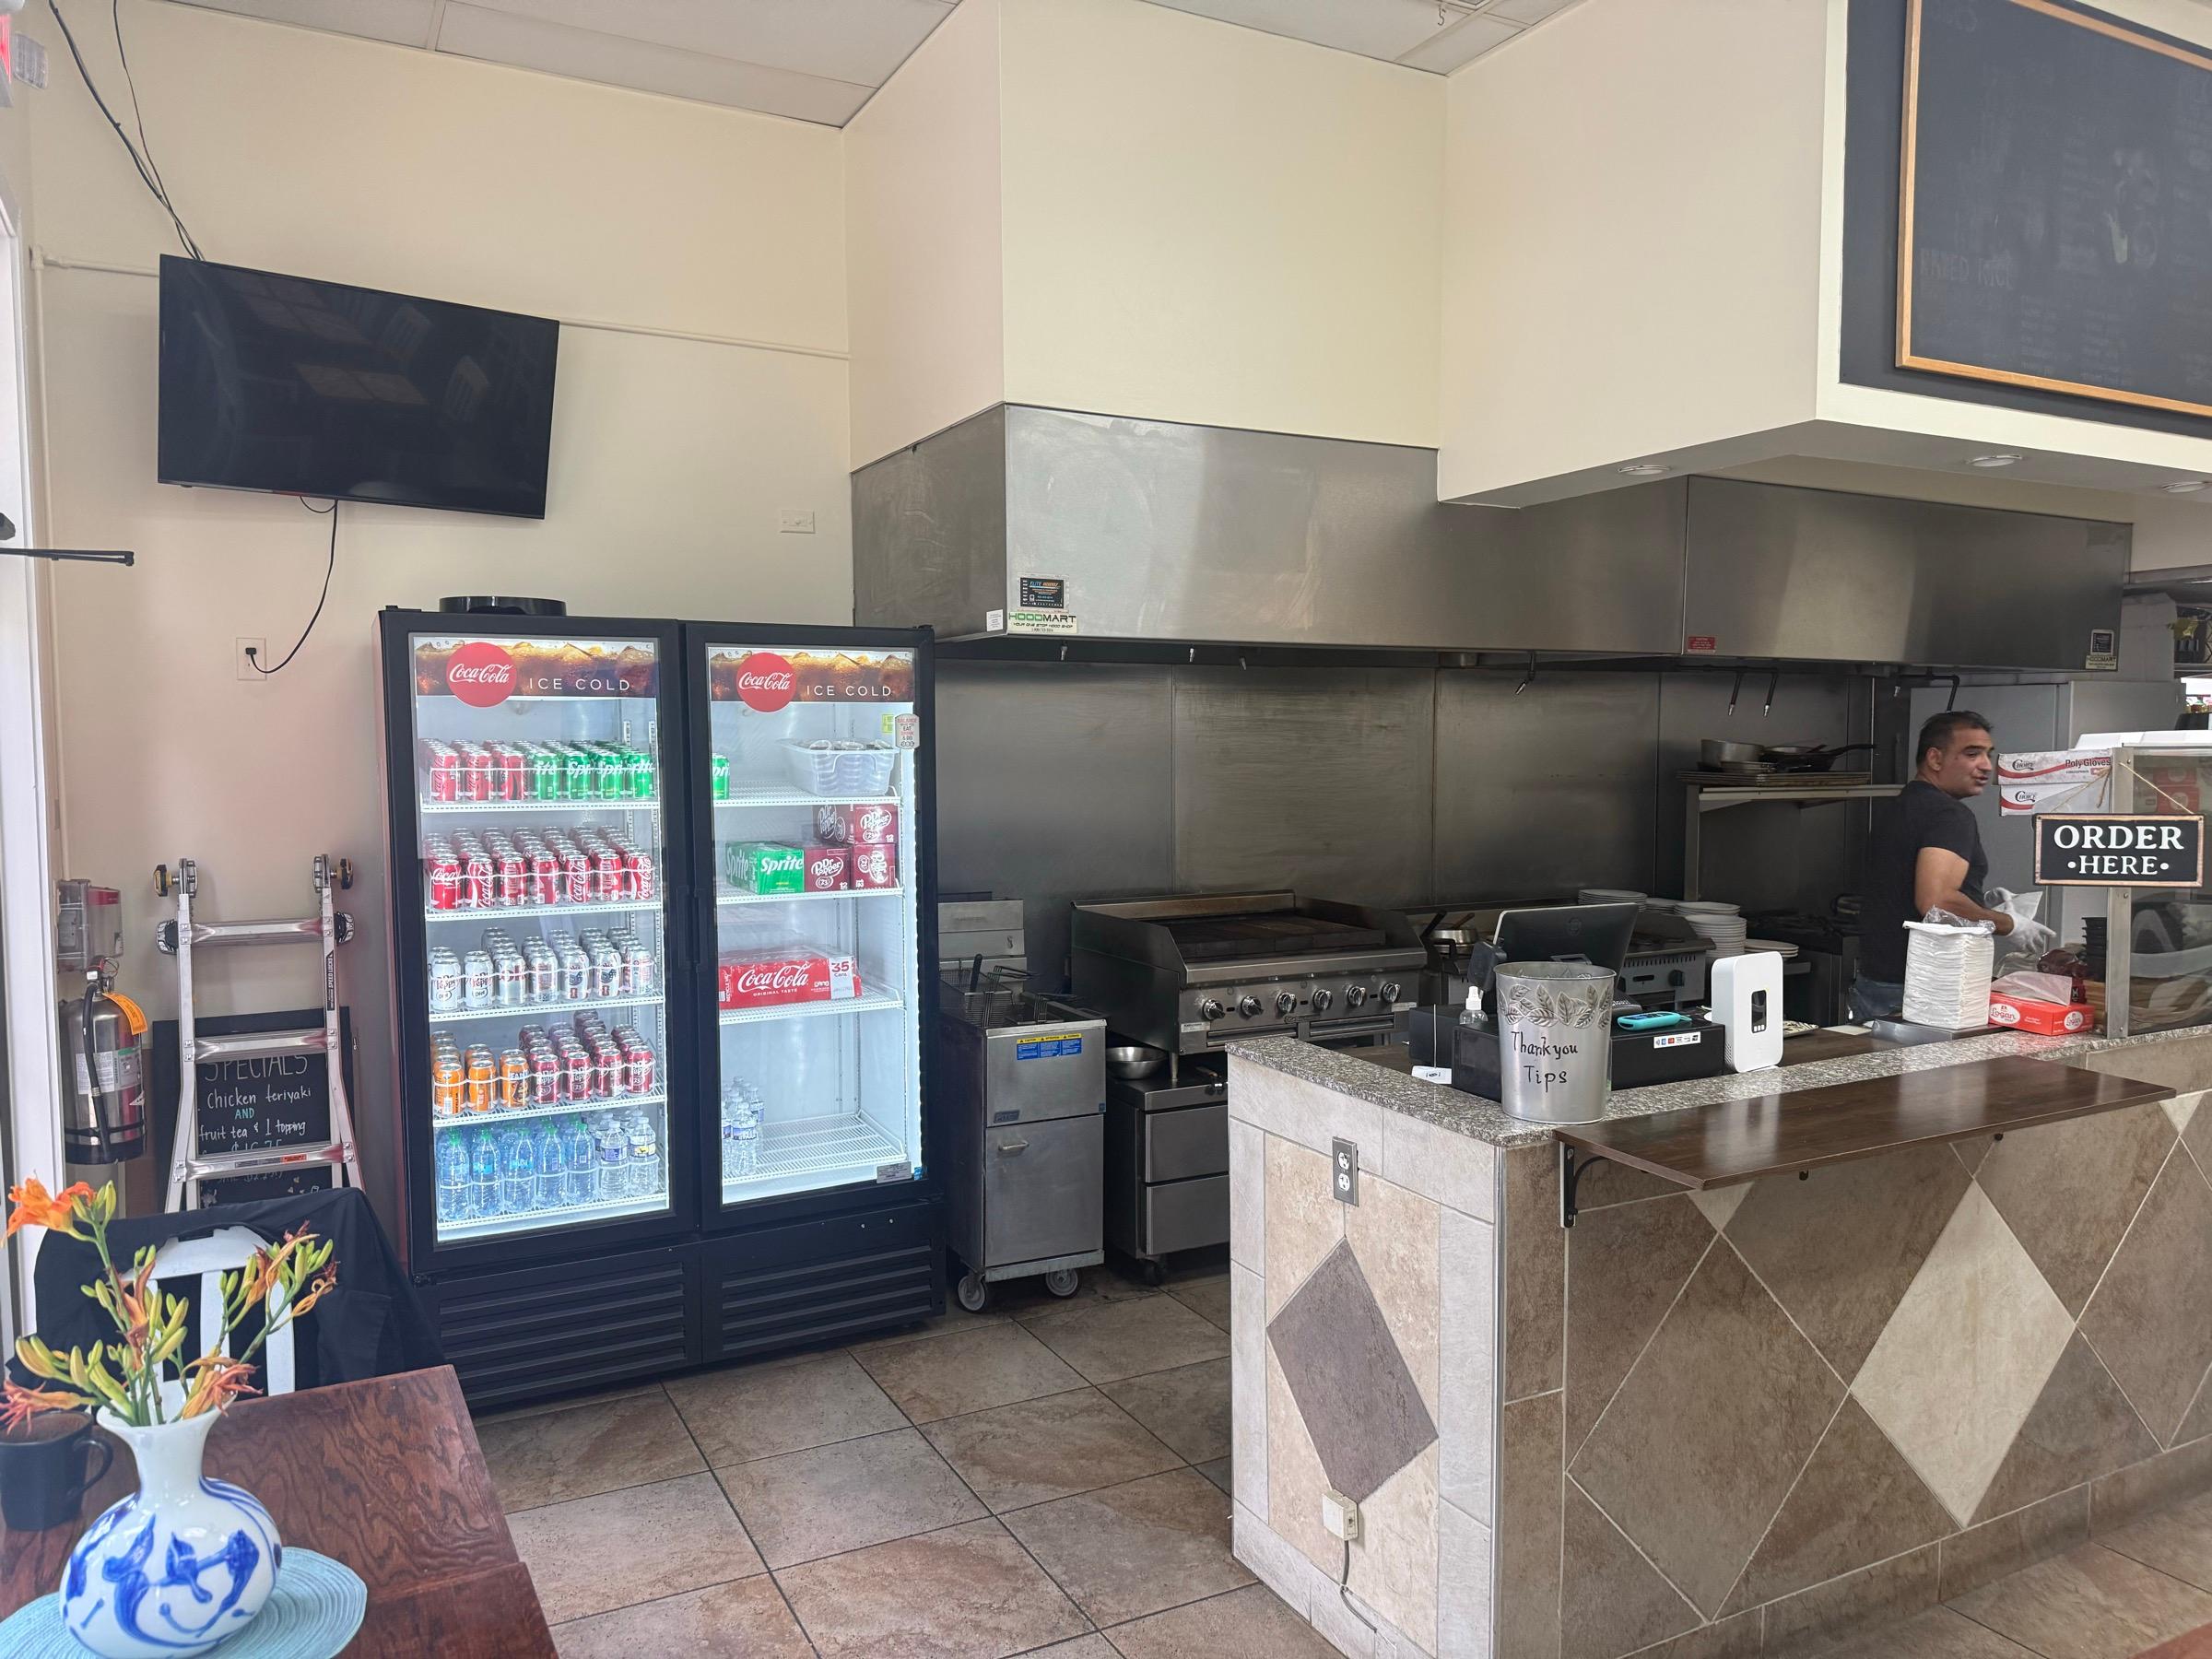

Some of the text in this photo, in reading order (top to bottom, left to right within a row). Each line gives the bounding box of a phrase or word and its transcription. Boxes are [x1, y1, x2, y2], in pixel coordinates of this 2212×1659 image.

[1008, 612, 1077, 623] HOODMART
[449, 663, 513, 684] Coca-Cola
[738, 671, 794, 691] Coca-Cola
[529, 677, 629, 691] ICE COLD
[806, 685, 892, 697] ICE COLD
[2065, 758, 2111, 769] Poly Gloves
[2053, 825, 2184, 850] ORDER
[760, 855, 804, 875] Sprite
[812, 861, 841, 877] Pepper
[822, 858, 834, 868] Dr
[2079, 855, 2158, 875] HERE
[831, 960, 850, 973] 35
[737, 960, 813, 993] Coca-Cola
[1991, 1007, 2016, 1019] Logan
[1524, 1065, 1568, 1093] Tips
[207, 1084, 312, 1109] Chicken teriyaki
[234, 1107, 254, 1120] AND
[198, 1124, 227, 1141] fruit
[230, 1126, 248, 1139] tea
[276, 1119, 307, 1136] topping
